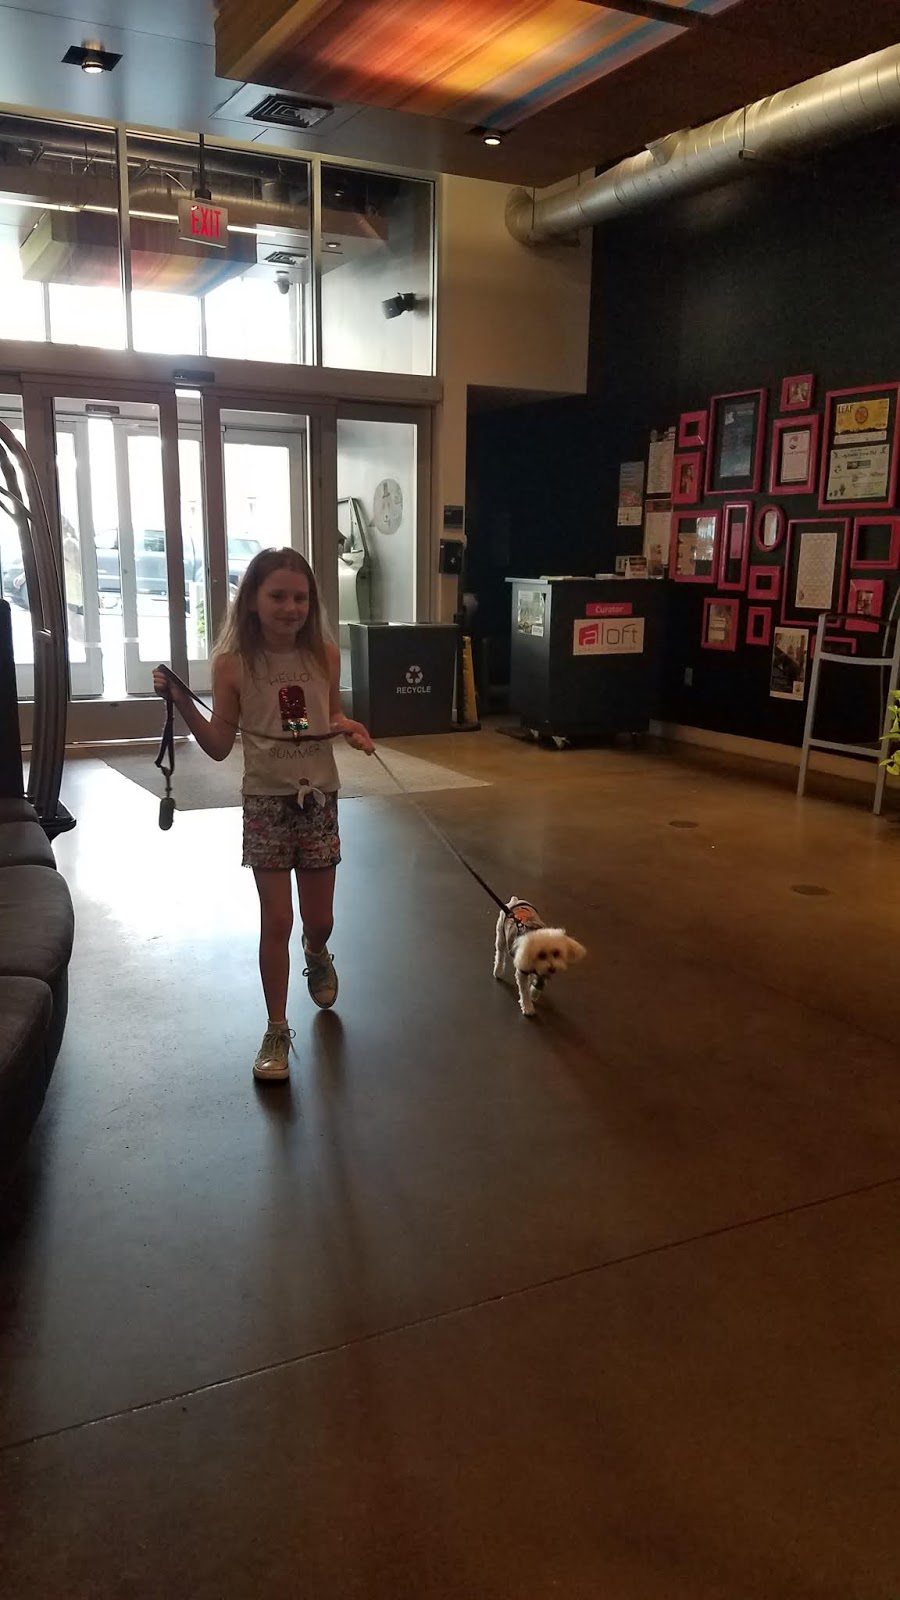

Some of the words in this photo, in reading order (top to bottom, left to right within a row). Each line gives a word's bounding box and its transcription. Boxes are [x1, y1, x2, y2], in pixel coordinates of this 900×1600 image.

[191, 205, 221, 238] EXIT
[838, 405, 854, 414] LEAF
[595, 605, 624, 614] Curator
[579, 621, 638, 646] aloft
[269, 672, 312, 686] HELLO
[396, 685, 431, 694] RECYCLE
